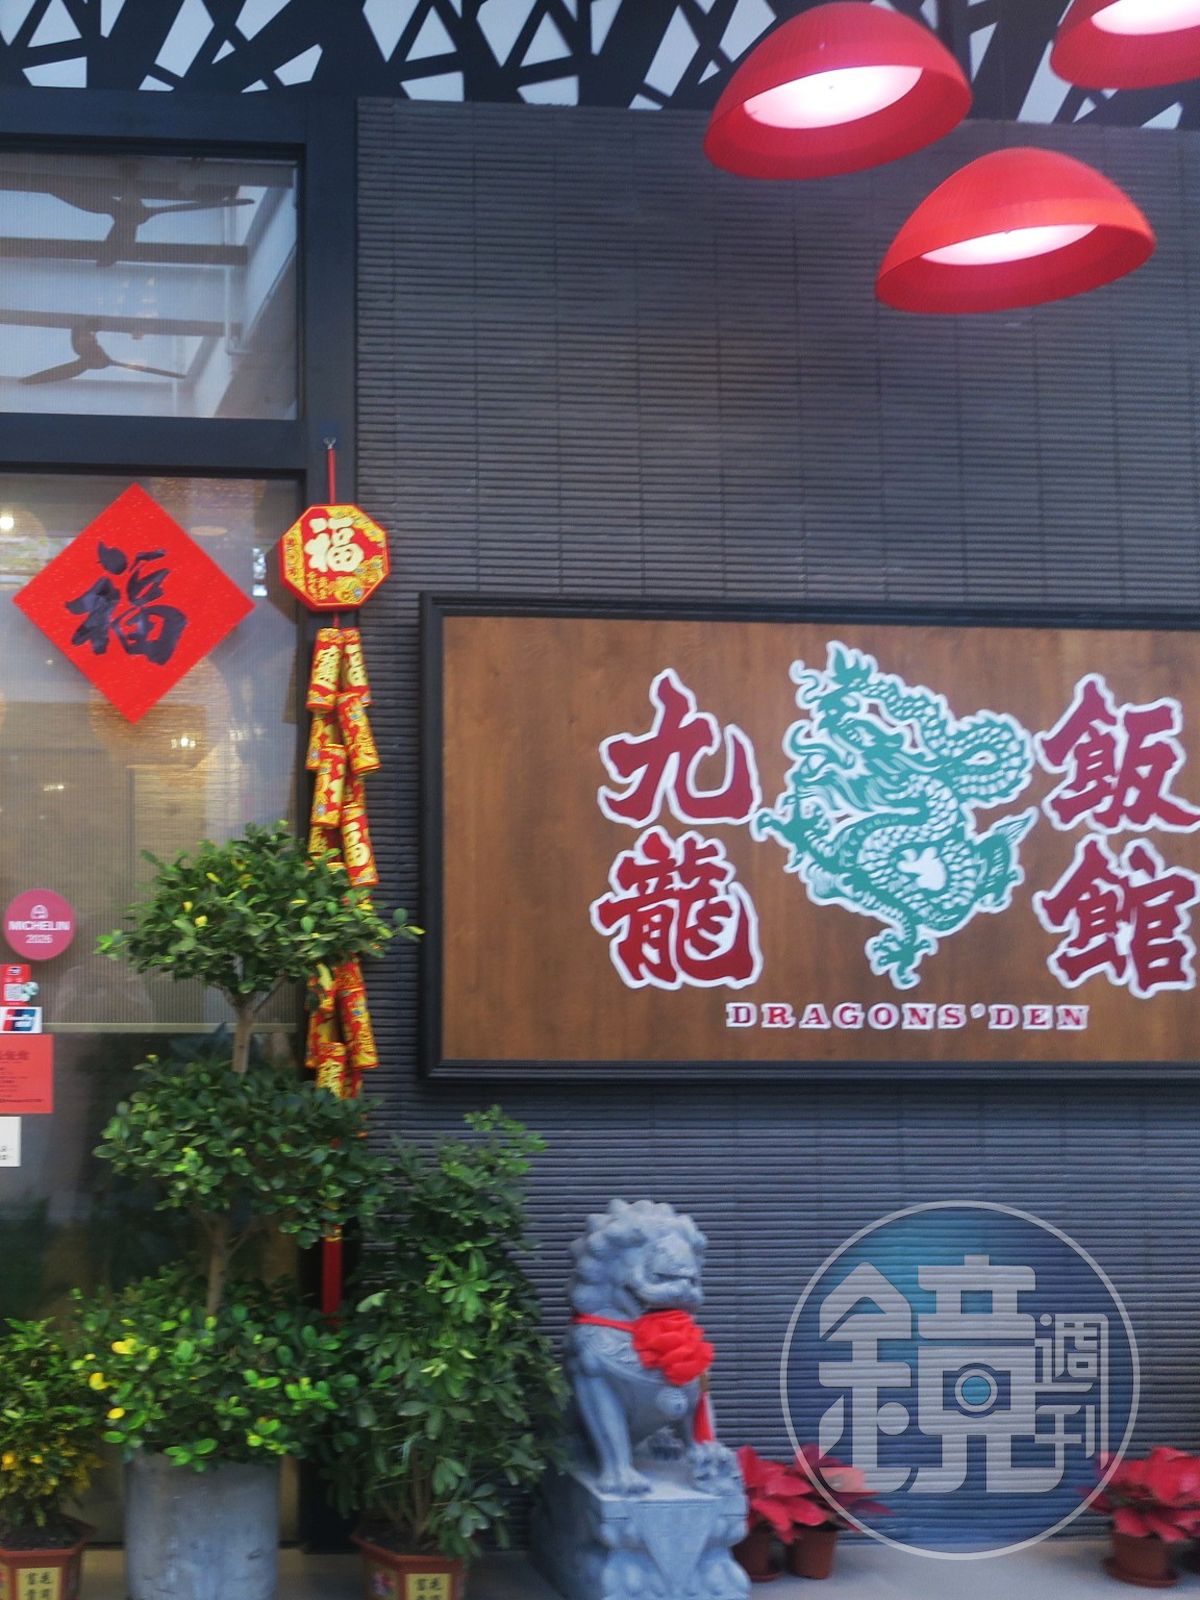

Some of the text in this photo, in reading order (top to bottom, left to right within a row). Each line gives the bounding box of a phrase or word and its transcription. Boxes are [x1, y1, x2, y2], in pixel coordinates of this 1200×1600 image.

[304, 517, 364, 572] 福
[65, 541, 188, 666] 福
[8, 920, 70, 931] MICHELIN
